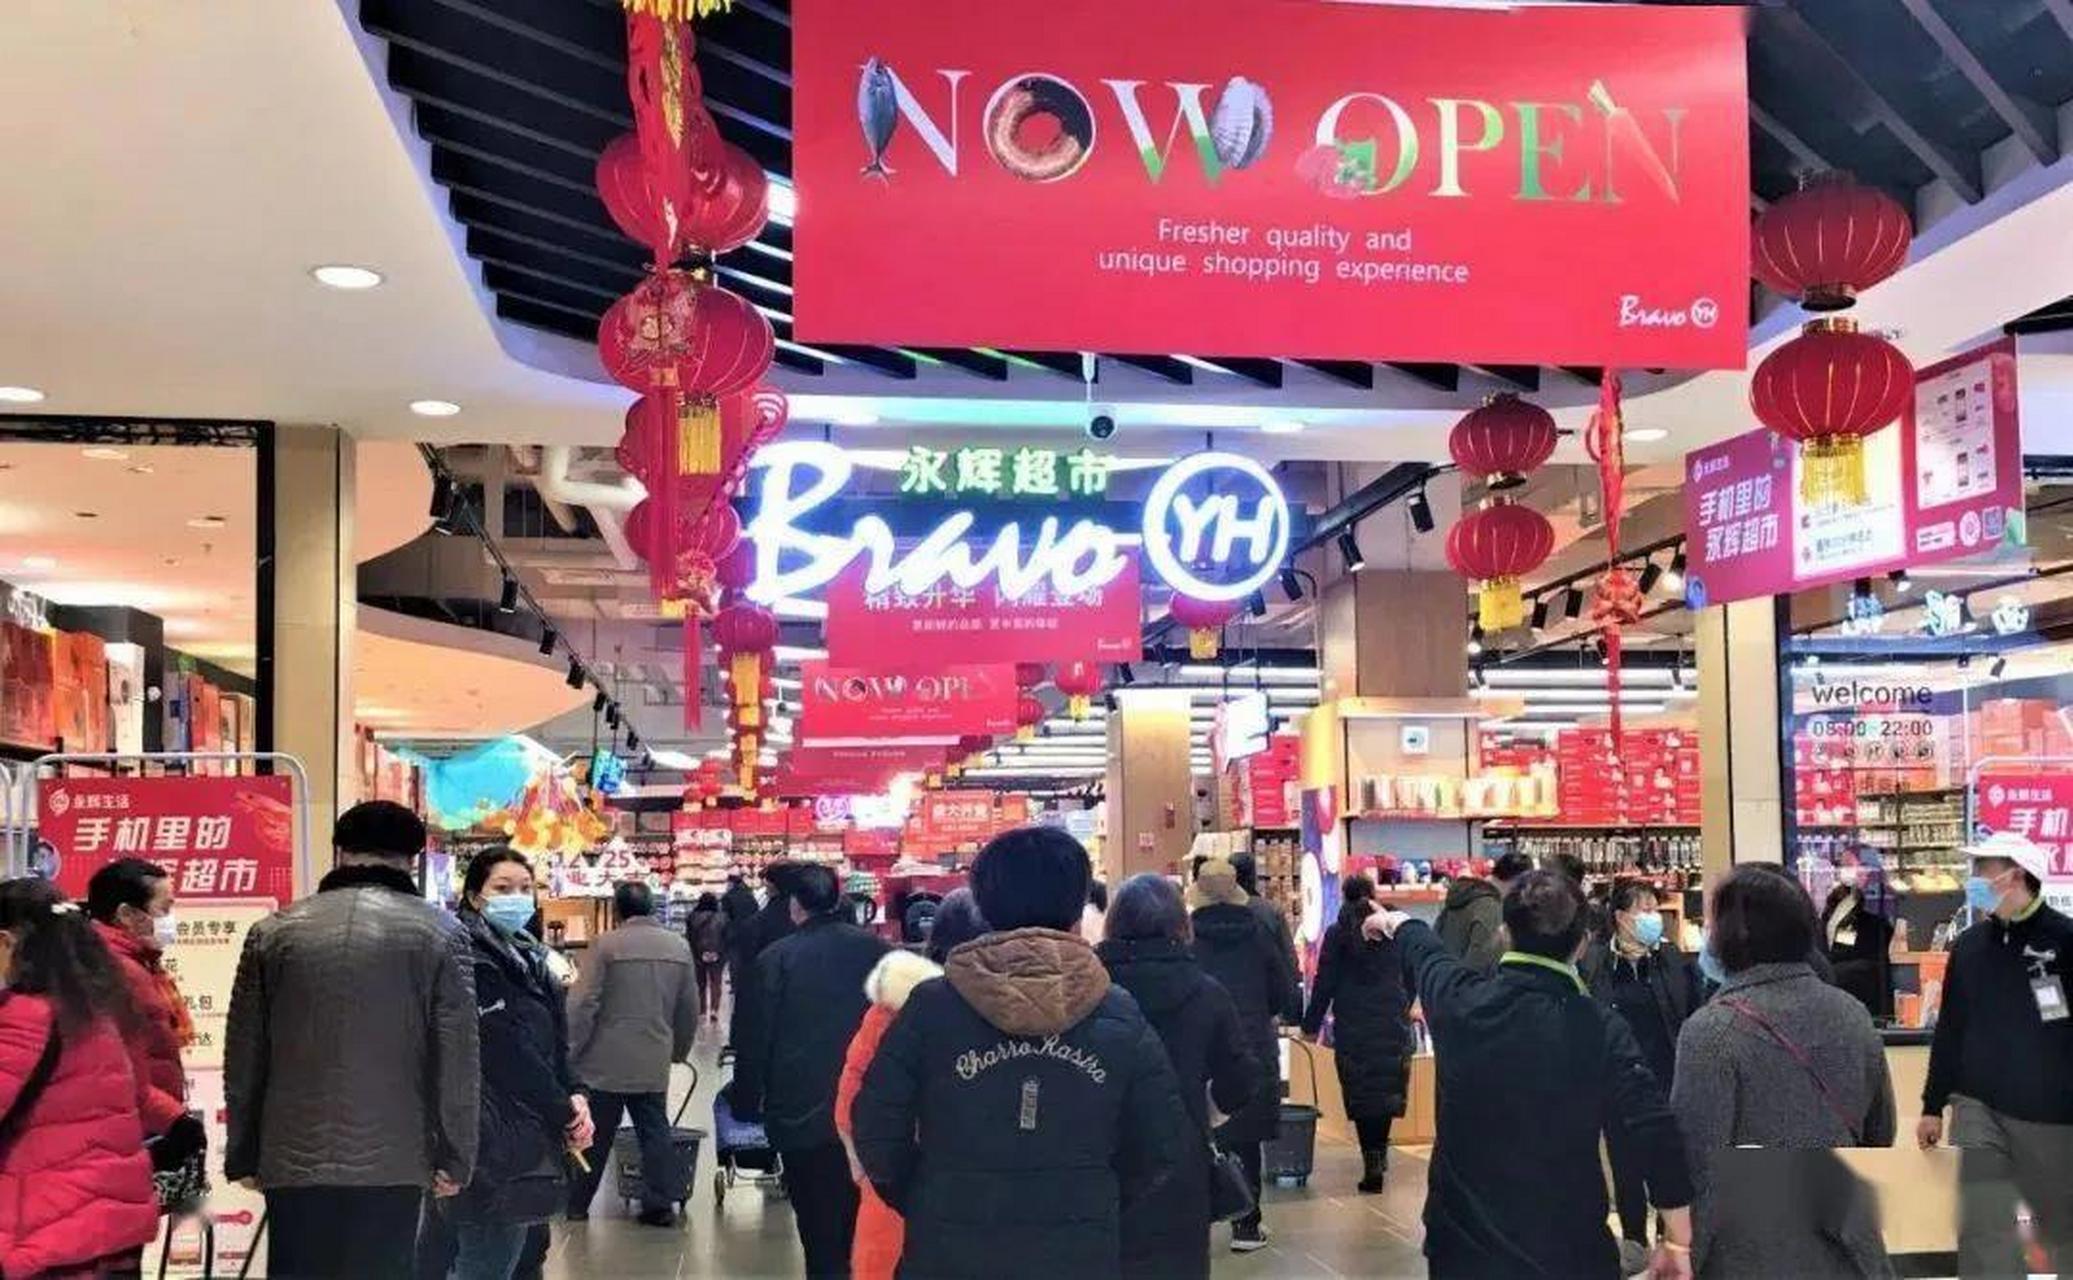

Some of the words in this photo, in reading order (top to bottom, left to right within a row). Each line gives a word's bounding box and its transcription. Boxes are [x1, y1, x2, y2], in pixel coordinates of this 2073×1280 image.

[858, 56, 1272, 186] NOW
[1296, 80, 1690, 205] OPEN
[1158, 220, 1250, 246] Fresher
[1267, 221, 1351, 253] quality
[1365, 226, 1412, 251] and
[1098, 250, 1187, 277] unique
[1202, 251, 1320, 284] shopping
[1335, 259, 1470, 285] experience
[1619, 294, 1687, 327] Bravo
[900, 448, 1111, 495] 永辉超市
[1699, 473, 1772, 526] 手机里的
[744, 440, 1128, 608] Bravo
[1705, 514, 1779, 562] 永辉超市
[815, 676, 907, 702] NOW
[1812, 681, 1932, 705] welcome
[1813, 722, 1867, 737] 08:00
[1881, 721, 1933, 737] 22:00
[73, 794, 130, 809] 永辉生活
[74, 815, 232, 852] 手机里的
[148, 857, 259, 893] 超市
[177, 920, 236, 936] 会员专享
